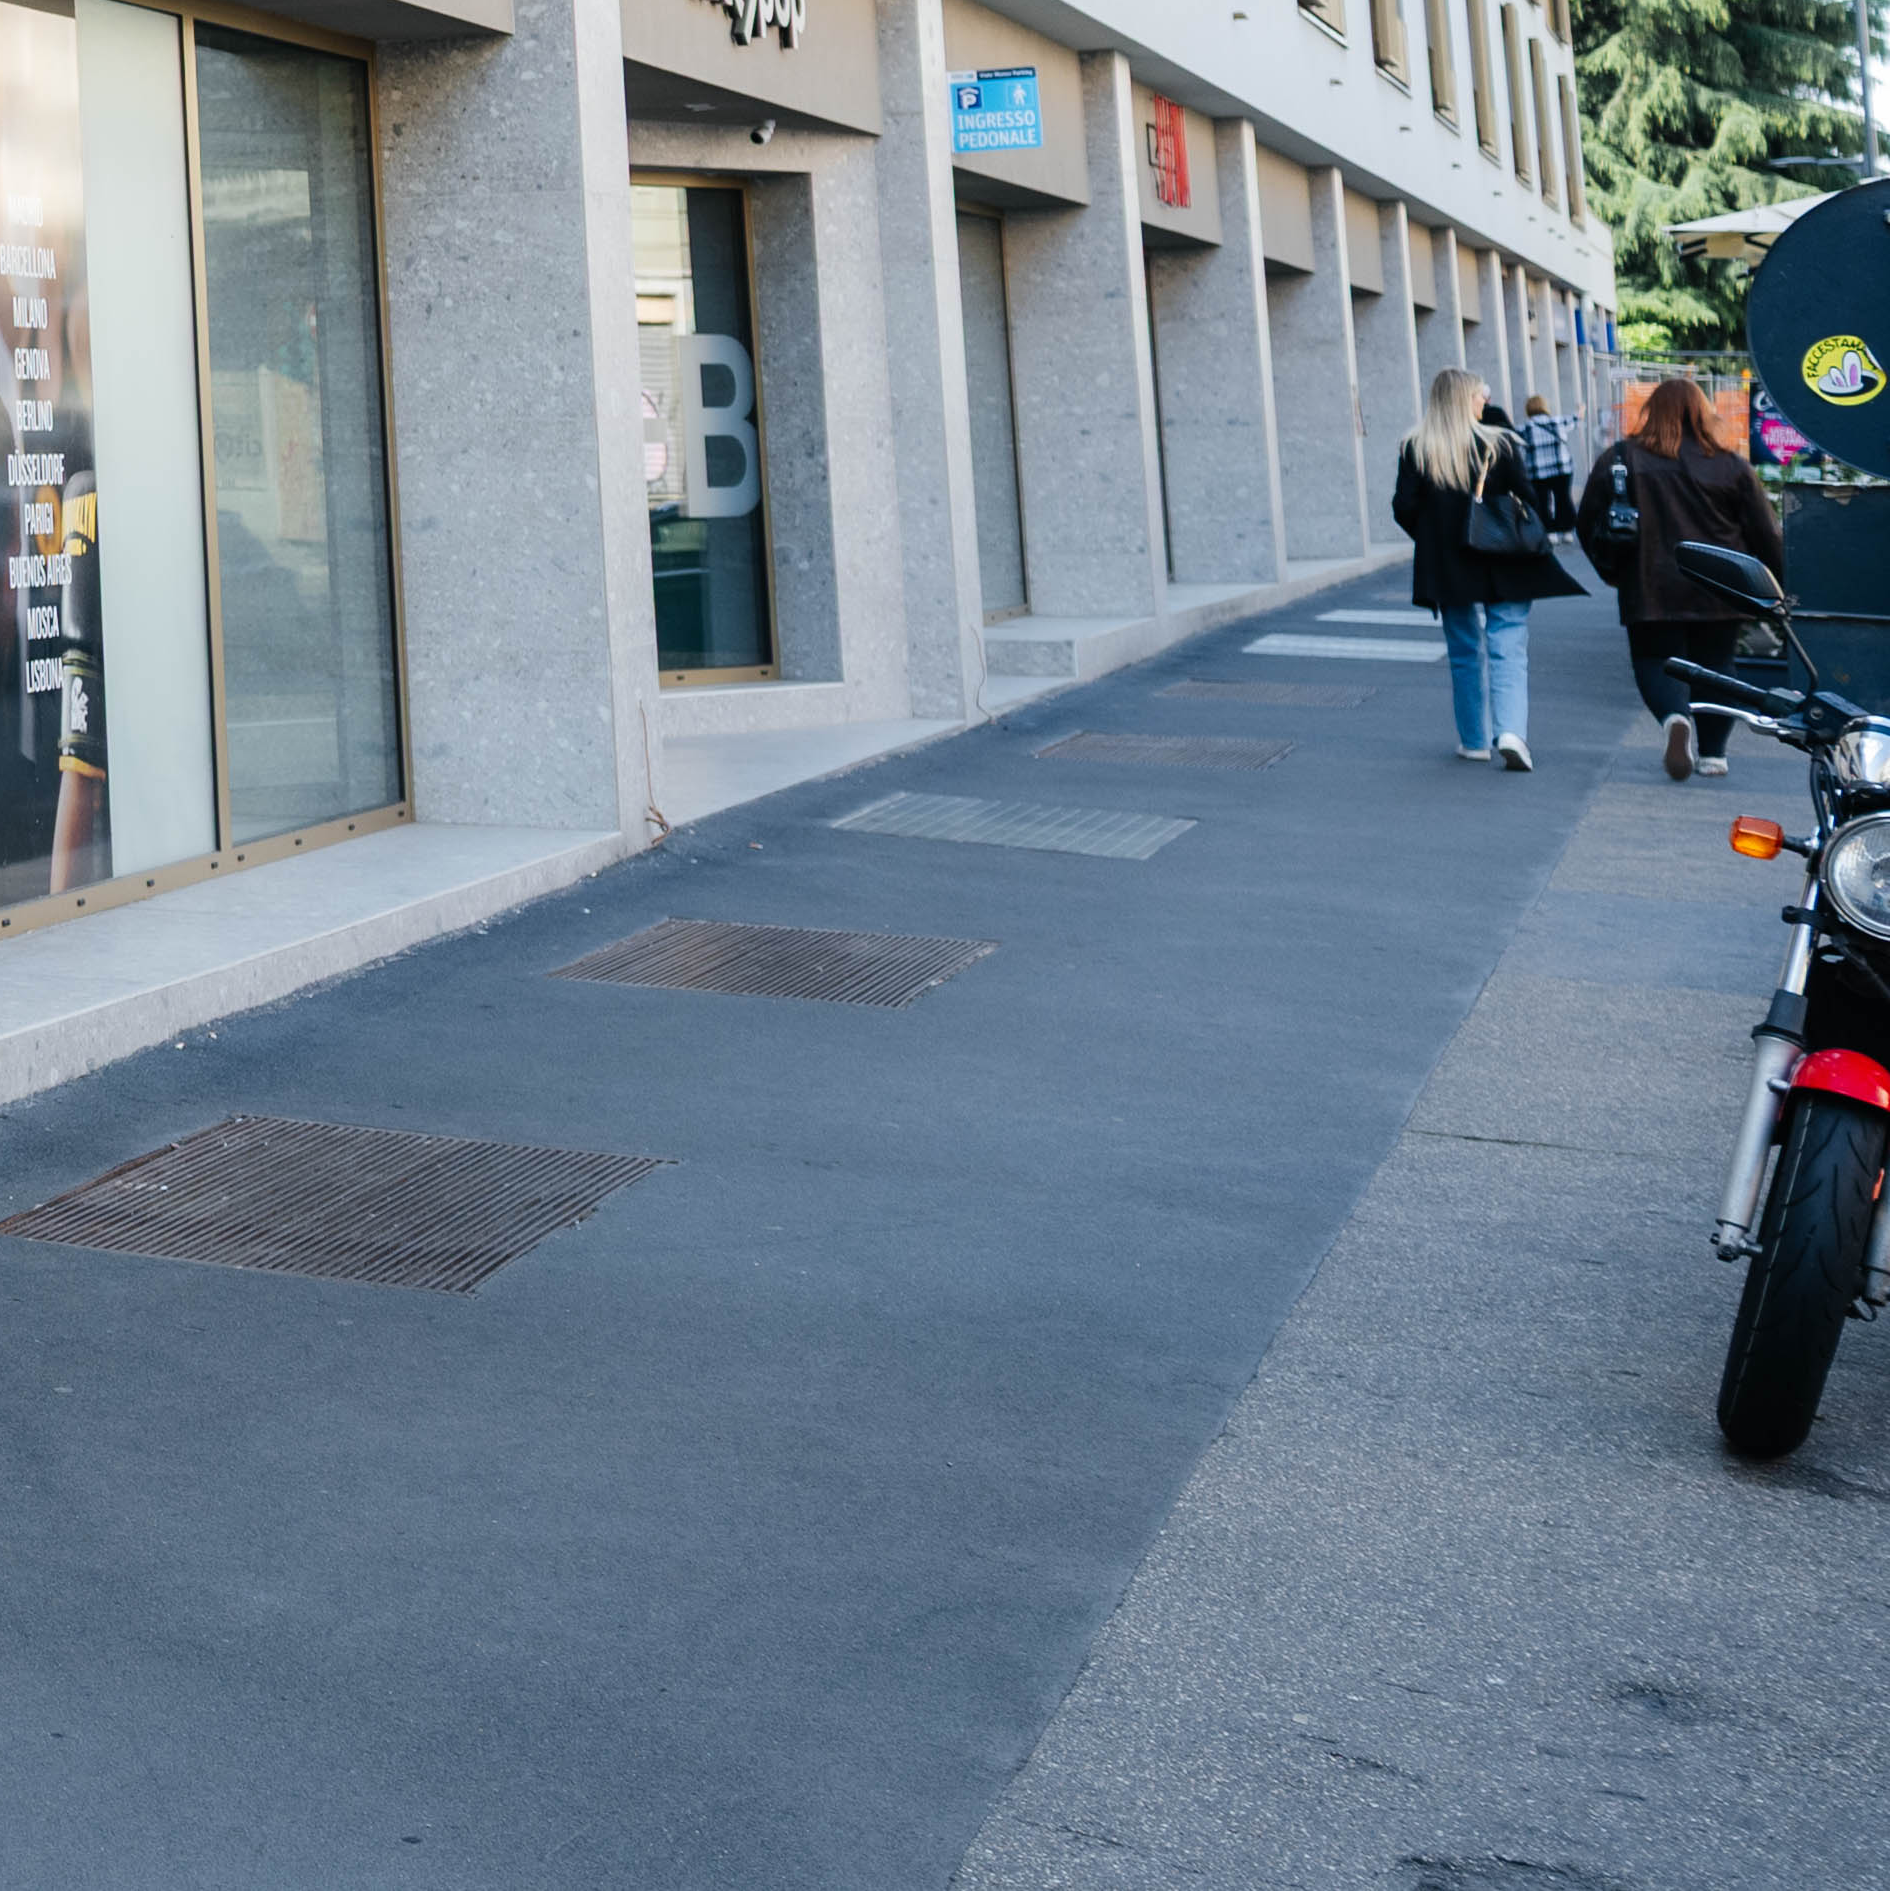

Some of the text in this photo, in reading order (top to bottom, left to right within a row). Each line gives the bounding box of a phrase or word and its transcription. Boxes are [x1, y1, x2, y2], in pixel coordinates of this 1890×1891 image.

[958, 110, 1036, 130] INGRESSO
[960, 128, 1038, 149] PEDONALE
[0, 245, 57, 279] BARCELLONA
[13, 296, 48, 330] MILANO
[14, 347, 51, 381] GENOVA
[16, 400, 53, 432] BERLINO
[7, 450, 65, 486] DÜSSELDORF
[24, 503, 54, 535] PARIGI
[9, 553, 72, 590] BUENOS AIRES
[26, 605, 60, 640] MOSCA
[25, 657, 65, 694] LISBONA
